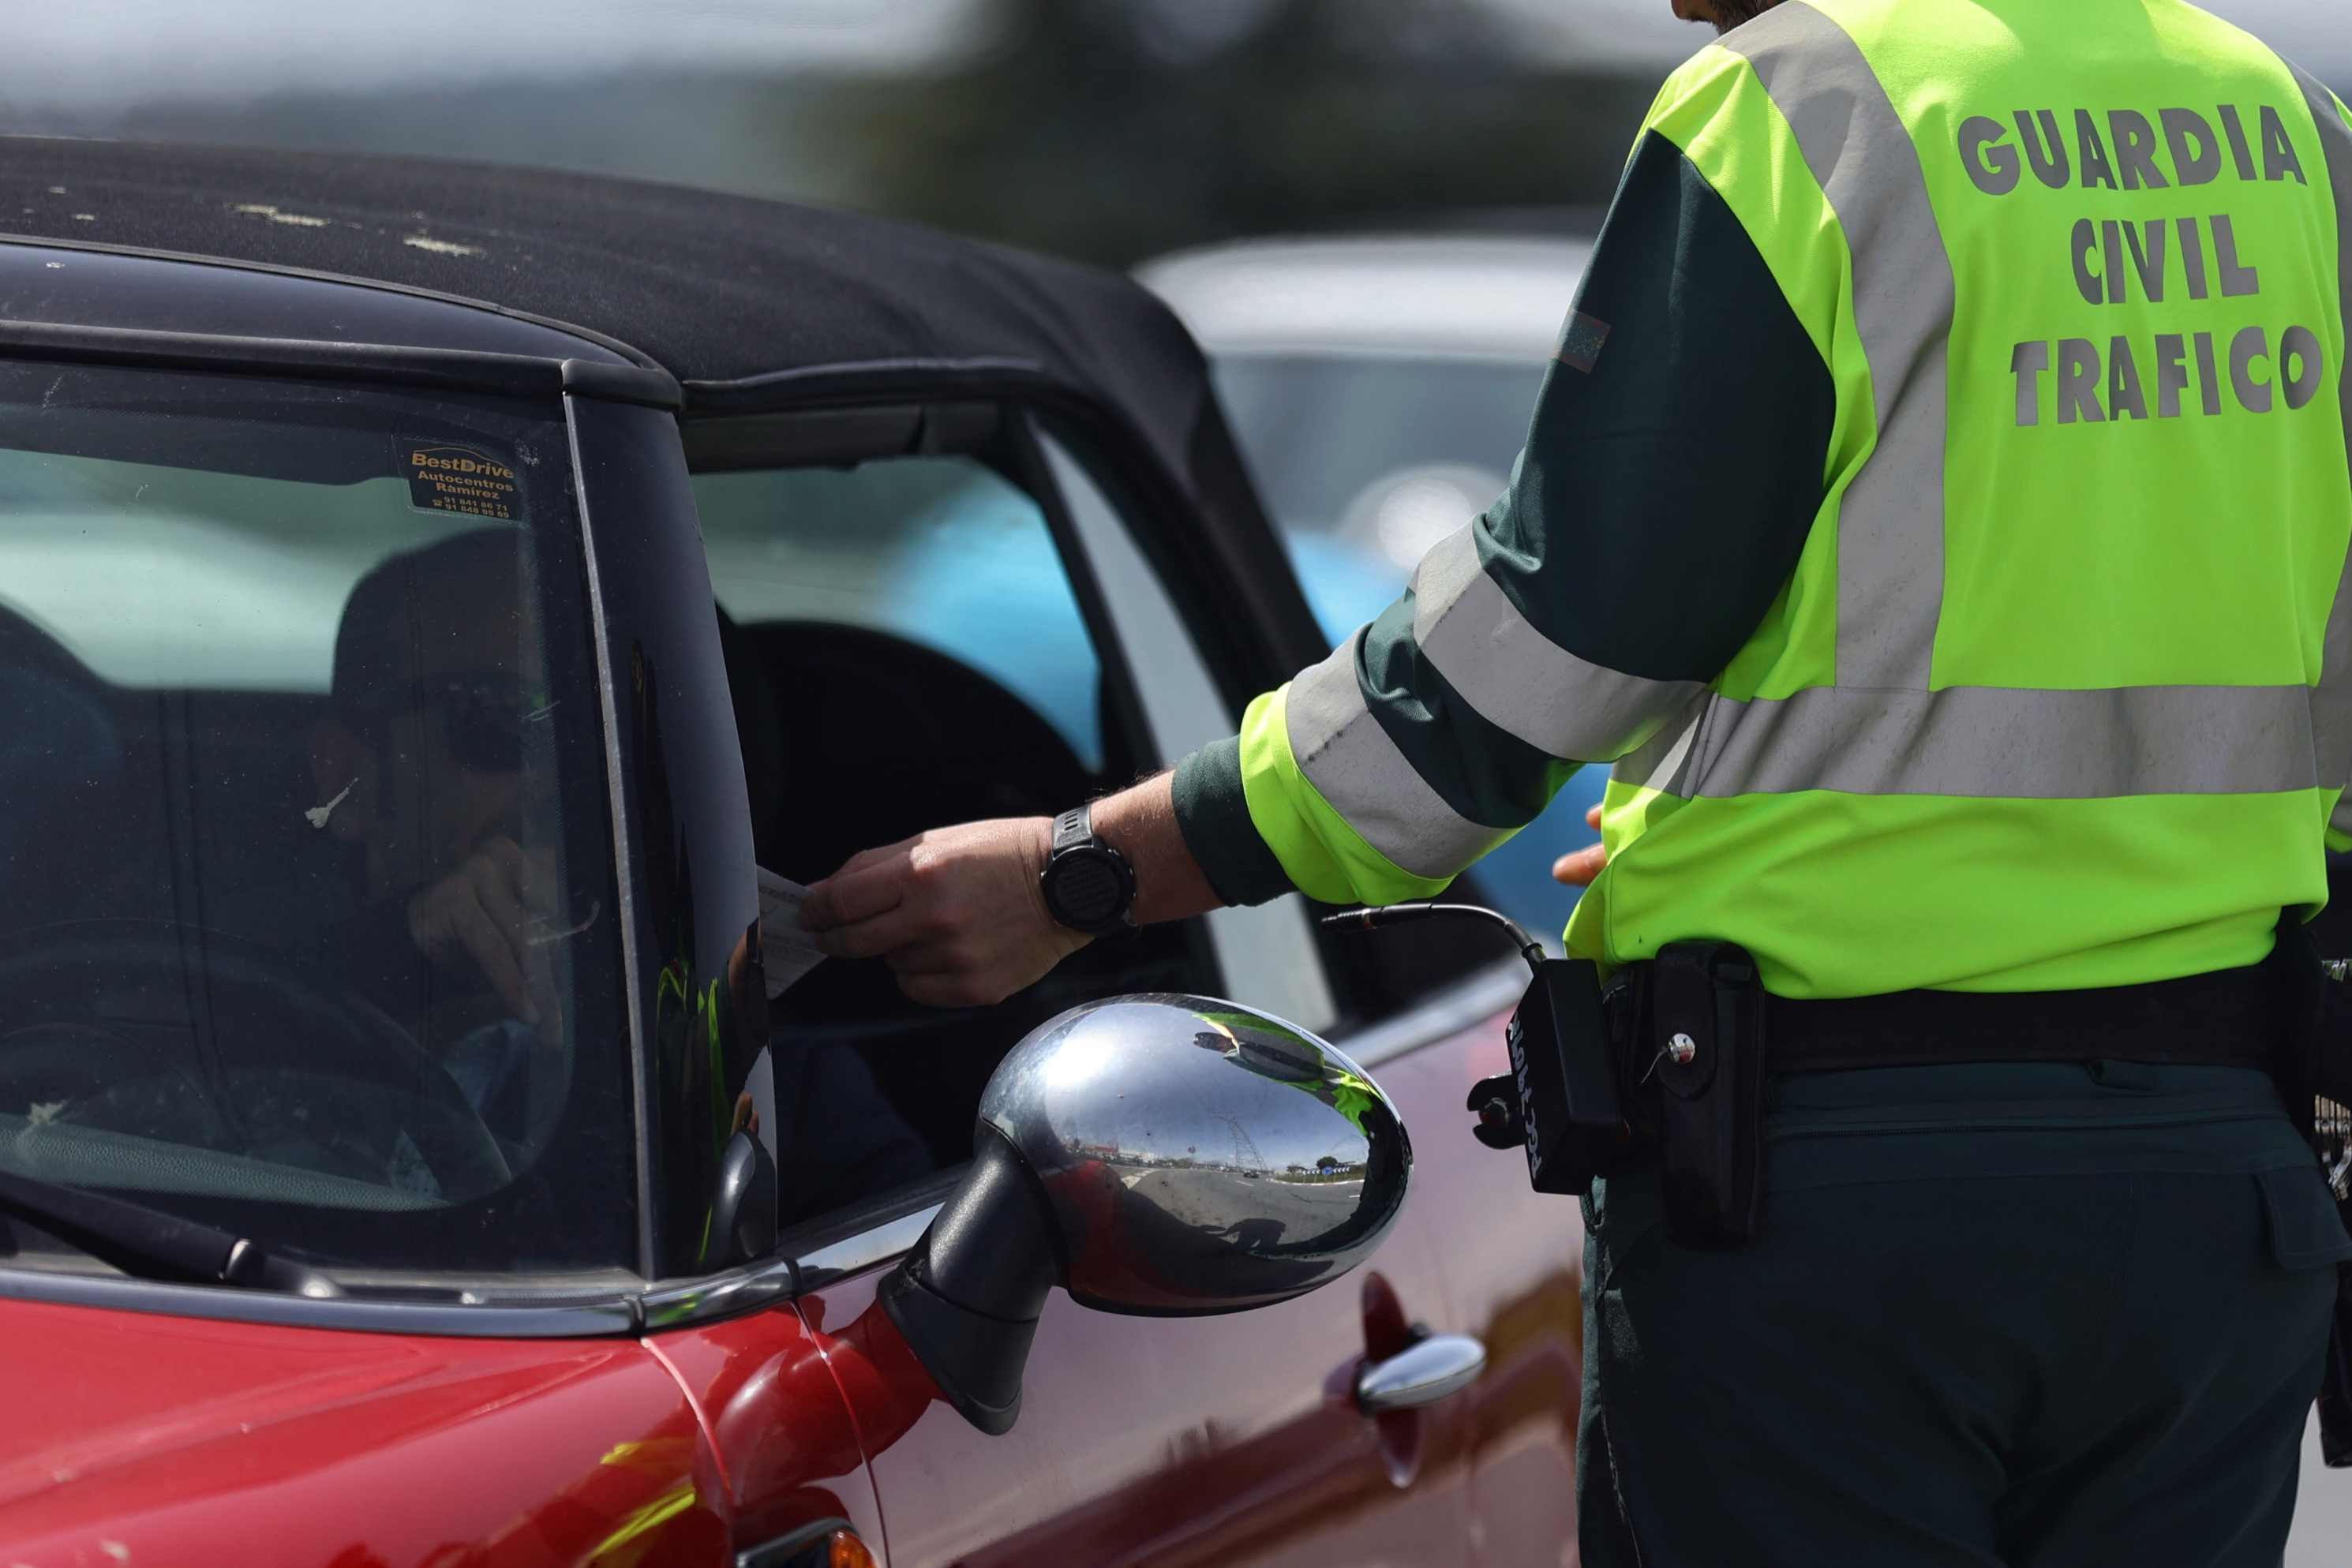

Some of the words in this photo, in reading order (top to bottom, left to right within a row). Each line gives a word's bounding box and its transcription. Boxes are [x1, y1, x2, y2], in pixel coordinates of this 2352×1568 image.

[1957, 104, 2308, 196] GUARDIA
[2070, 214, 2260, 305] CIVIL
[2009, 325, 2323, 427] TRAFICO
[412, 453, 514, 478] BestDrive
[418, 471, 513, 492] Autocentros
